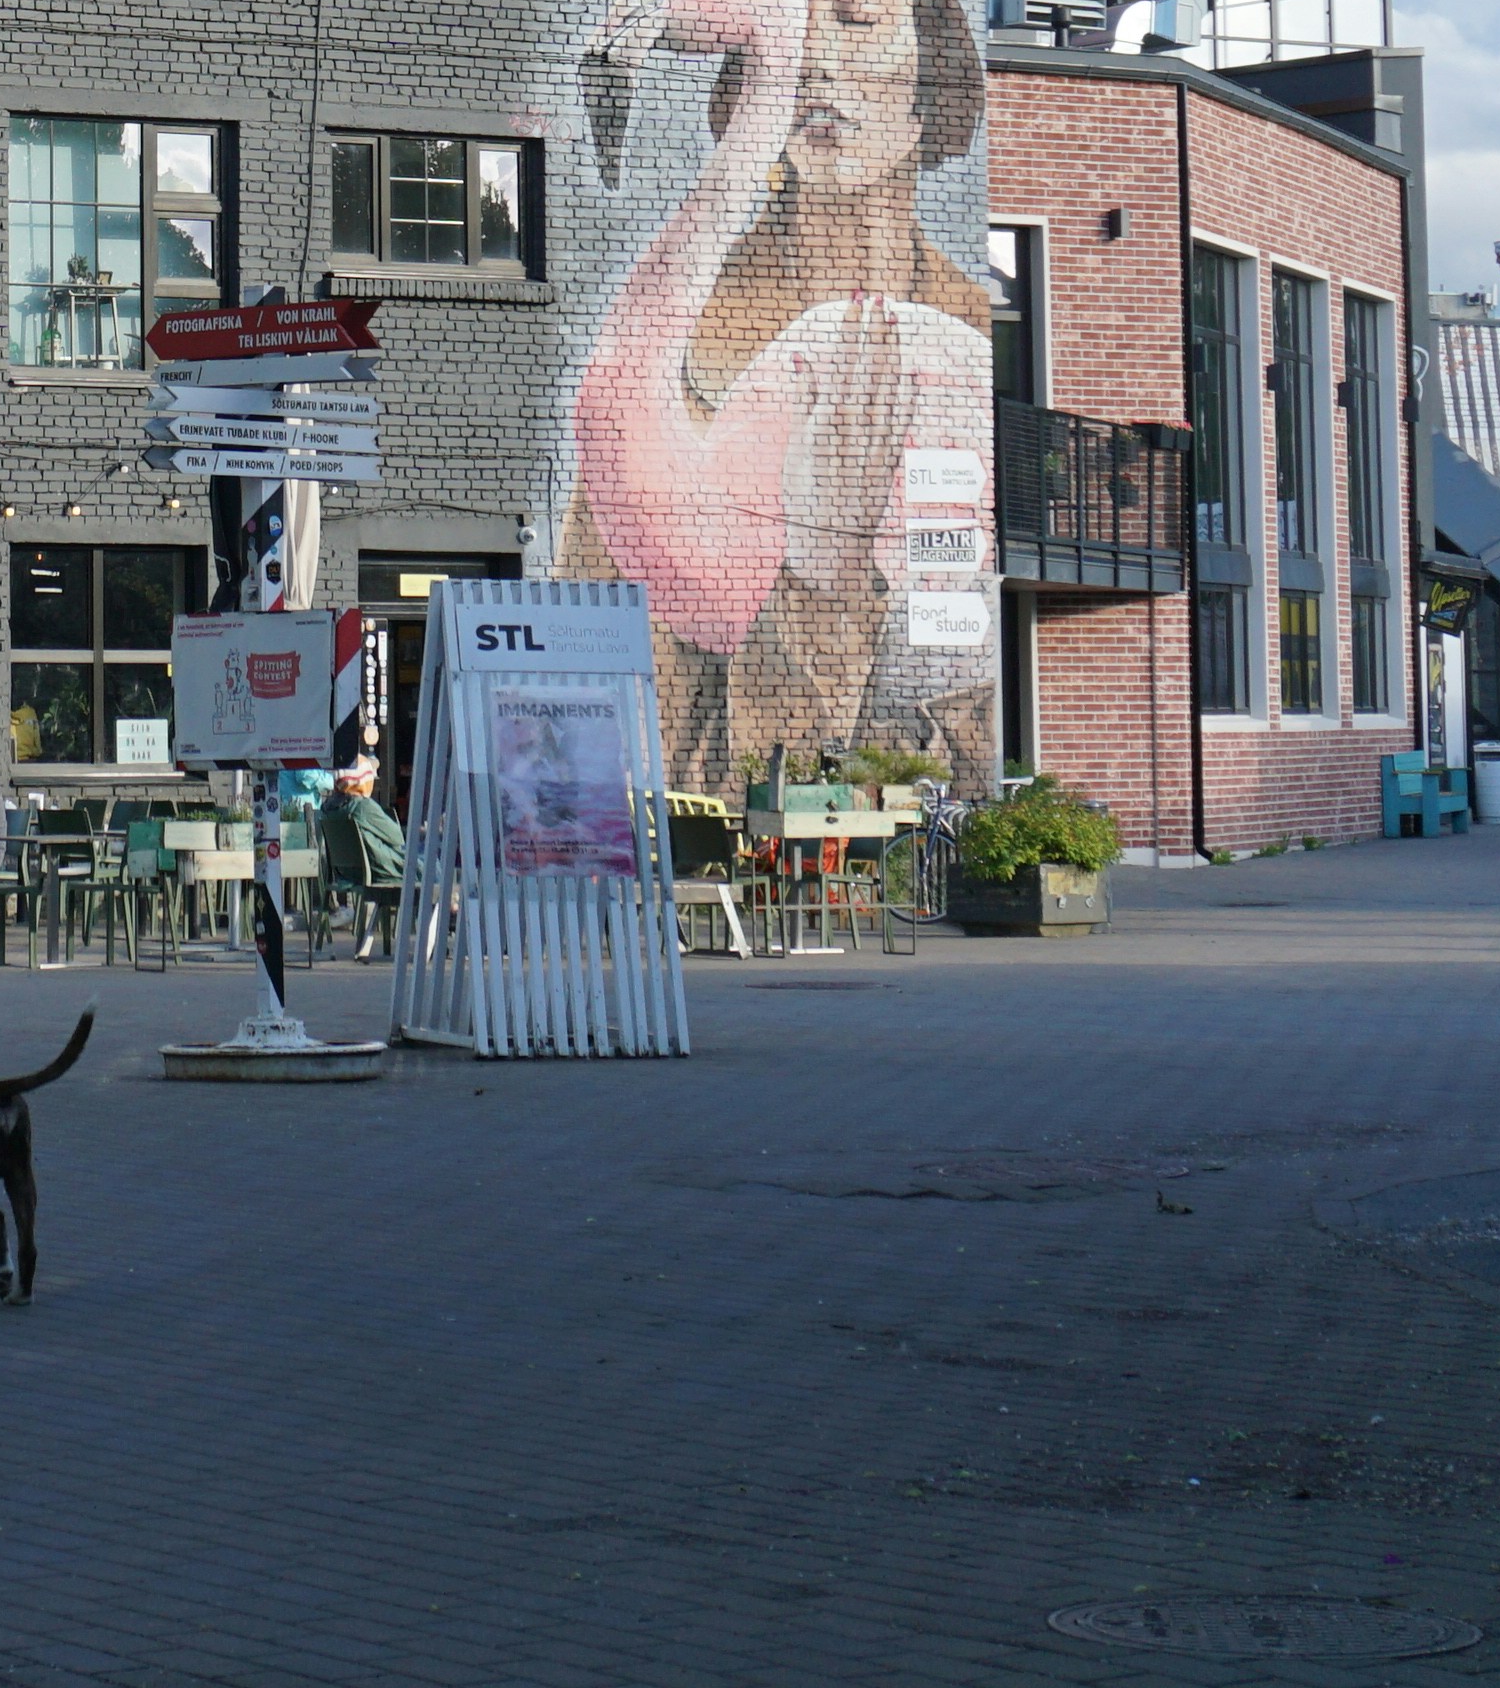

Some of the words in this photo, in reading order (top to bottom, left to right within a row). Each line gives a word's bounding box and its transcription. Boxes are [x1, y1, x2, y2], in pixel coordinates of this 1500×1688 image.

[165, 315, 242, 334] FOTOGRAFISKA
[276, 310, 299, 324] VON
[301, 307, 337, 323] KRAHL
[296, 327, 338, 345] VÄLJAK
[320, 401, 348, 412] TANTSU
[350, 403, 369, 413] LAVA
[227, 427, 260, 439] TUBADE
[262, 428, 287, 441] KLUBI
[303, 432, 339, 444] F-HOONE
[187, 456, 207, 467] FIKA
[909, 469, 937, 485] STL
[922, 529, 976, 548] TEATRI
[921, 550, 976, 562] AGENTUUR
[936, 617, 980, 633] studio
[475, 624, 546, 652] STL
[548, 625, 620, 639] Sõltumatu
[550, 640, 595, 653] Tantsu
[598, 641, 630, 654] Lava
[253, 658, 293, 671] SPITTING
[253, 671, 292, 680] CONTEST
[498, 703, 616, 719] IMMANENTS
